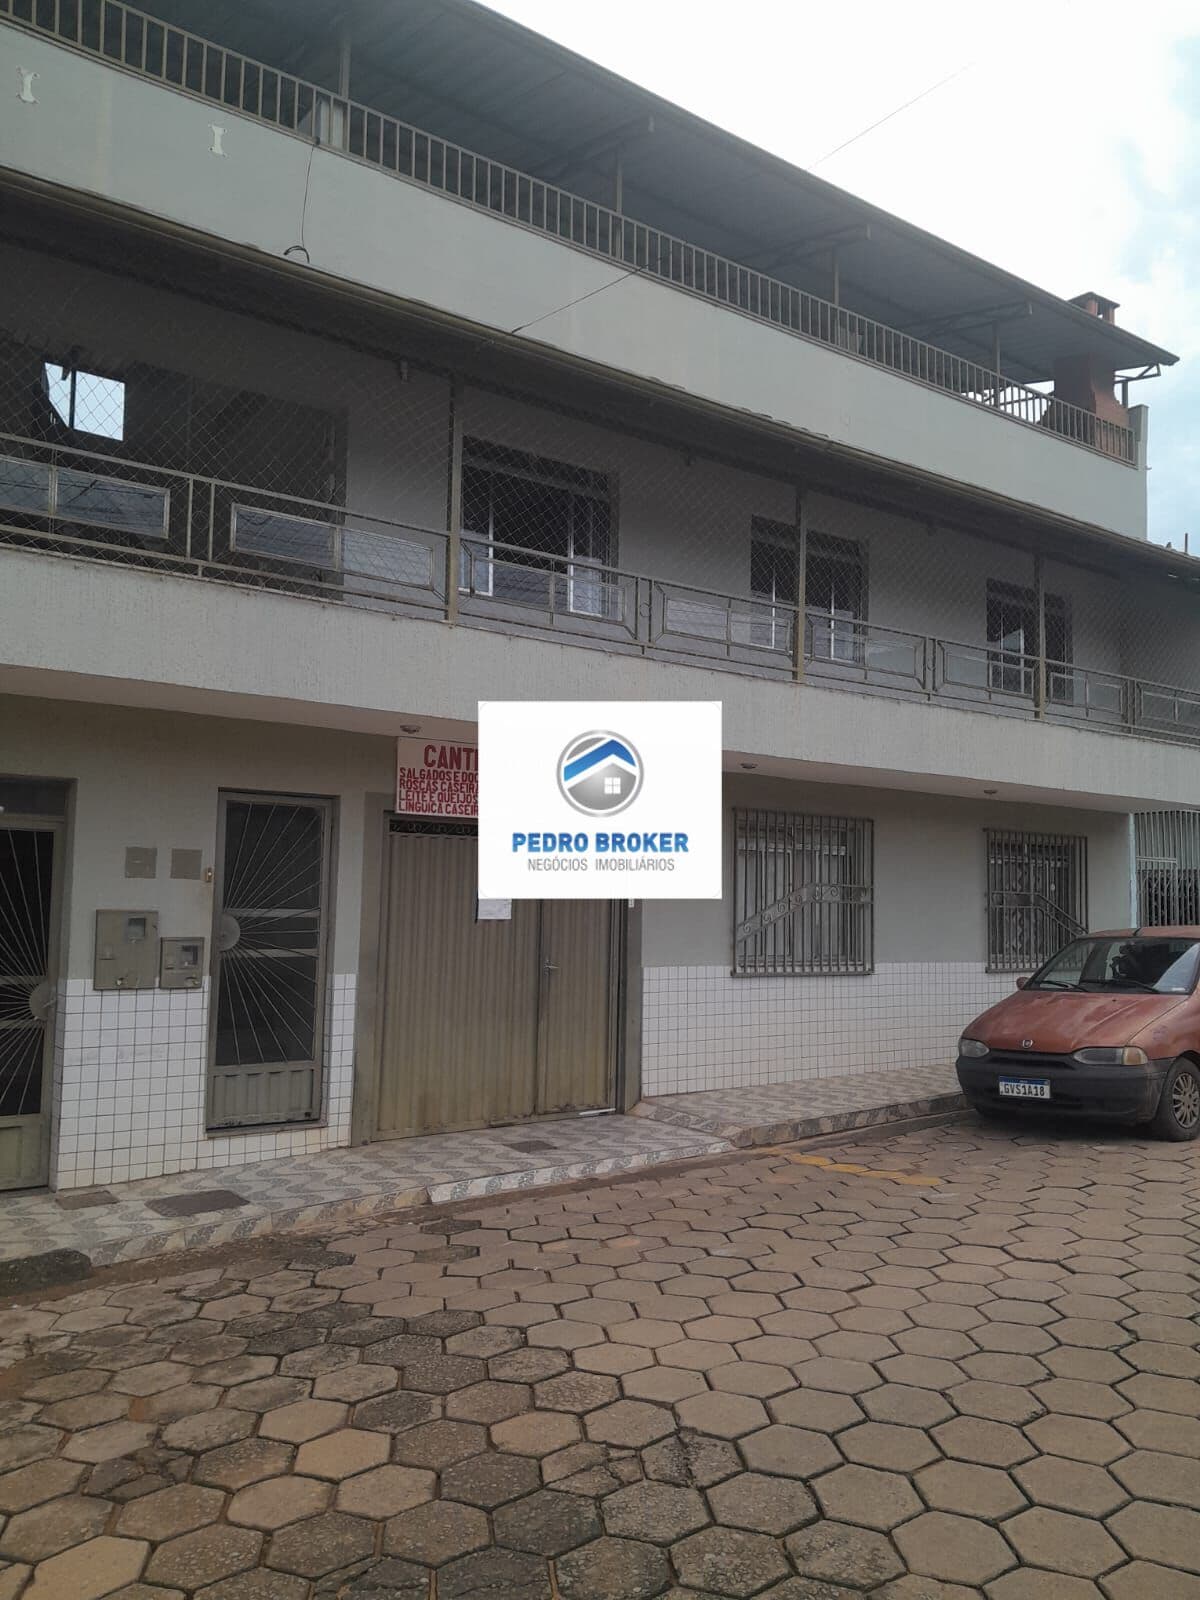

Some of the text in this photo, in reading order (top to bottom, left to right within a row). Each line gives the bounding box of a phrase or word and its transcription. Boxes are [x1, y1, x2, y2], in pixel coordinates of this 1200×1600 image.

[400, 767, 452, 781] SALGADOS
[454, 771, 460, 782] E
[400, 779, 438, 791] ROSCAS
[399, 790, 427, 802] LEITE
[430, 791, 436, 802] E
[1004, 1083, 1045, 1096] GVS1A18
